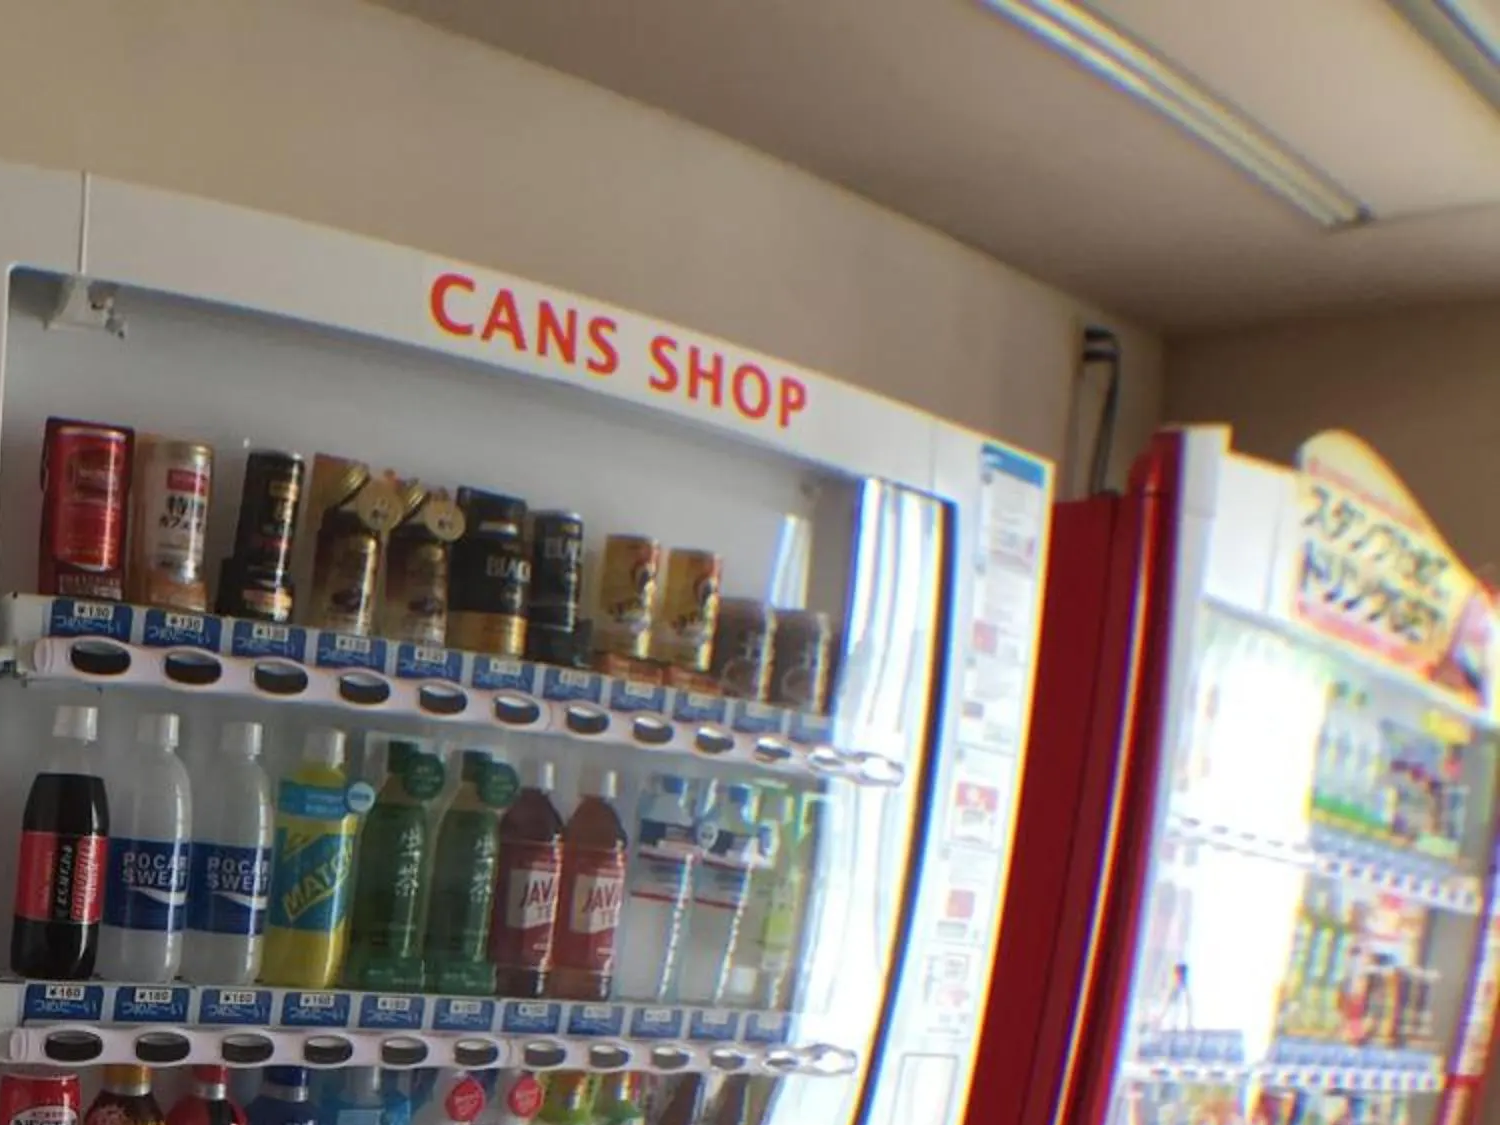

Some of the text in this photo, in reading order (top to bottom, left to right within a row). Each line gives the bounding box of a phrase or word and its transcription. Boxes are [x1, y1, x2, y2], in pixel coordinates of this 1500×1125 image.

[429, 272, 808, 428] CANS SHOP
[122, 851, 188, 871] POCAR
[519, 877, 554, 909] JAV
